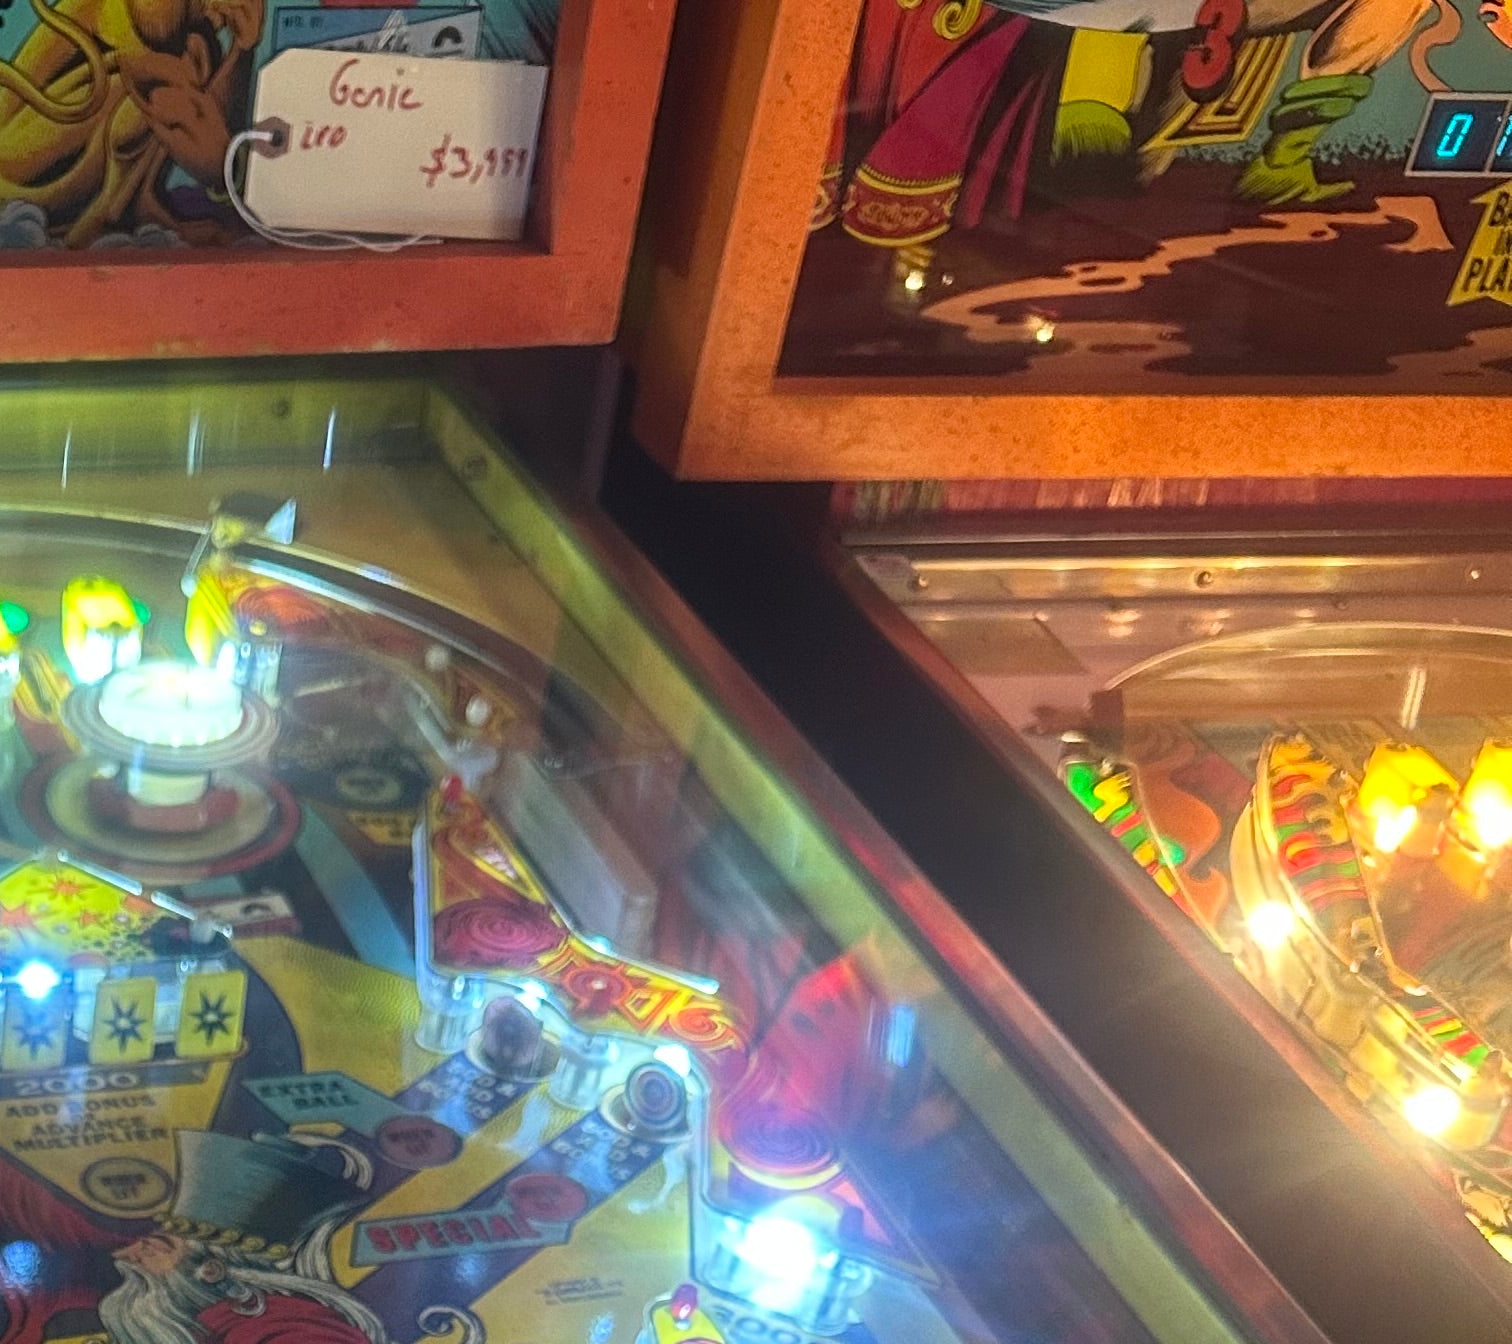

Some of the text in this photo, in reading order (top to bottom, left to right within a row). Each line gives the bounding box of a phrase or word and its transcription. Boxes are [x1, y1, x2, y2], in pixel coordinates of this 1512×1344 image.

[1437, 113, 1474, 158] 0
[14, 1070, 139, 1098] 2000
[258, 1079, 344, 1099] EXTRA
[6, 1101, 58, 1119] ADD
[292, 1093, 360, 1110] BALL
[31, 1116, 147, 1136] ADVANCE
[12, 1127, 172, 1151] MULTIPLIER
[366, 1210, 544, 1255] SPECIAL
